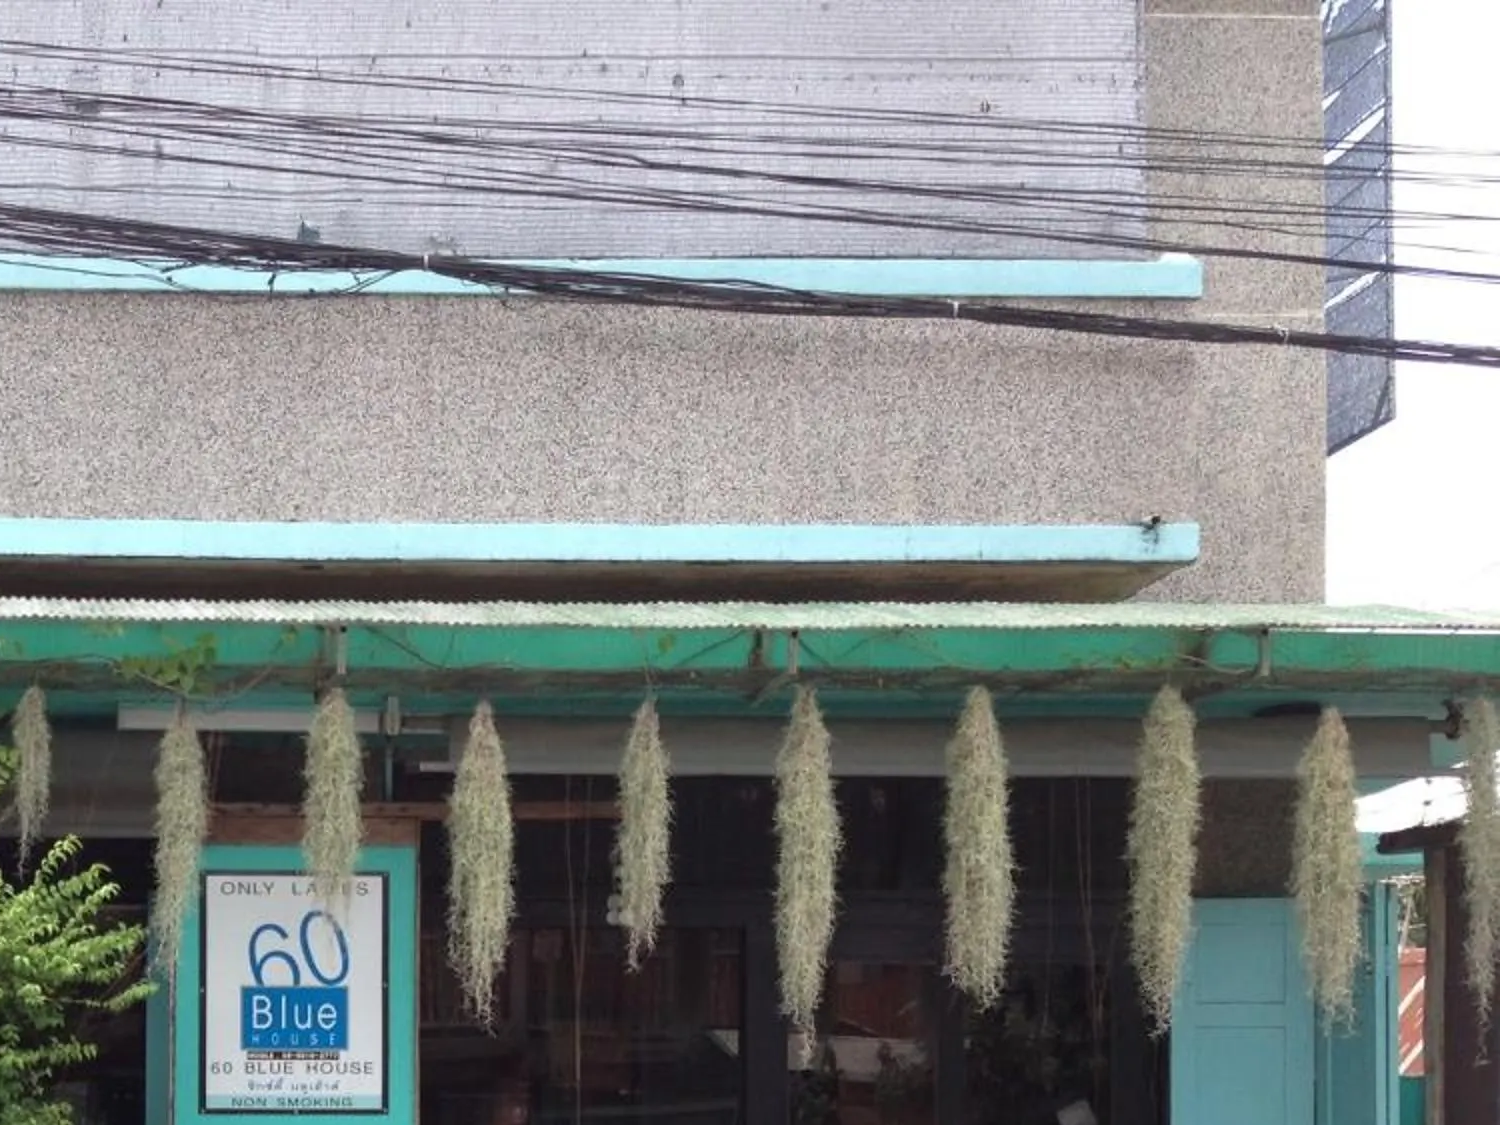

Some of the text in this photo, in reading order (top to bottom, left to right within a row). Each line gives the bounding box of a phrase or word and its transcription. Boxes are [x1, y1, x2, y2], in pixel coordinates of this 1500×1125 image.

[220, 881, 275, 896] ONLY
[248, 909, 349, 986] 60
[252, 994, 337, 1030] Blue
[251, 1033, 338, 1046] HOUSE
[210, 1061, 374, 1075] 60 BLUE HOUSE
[231, 1097, 354, 1107] NON SMOKING
